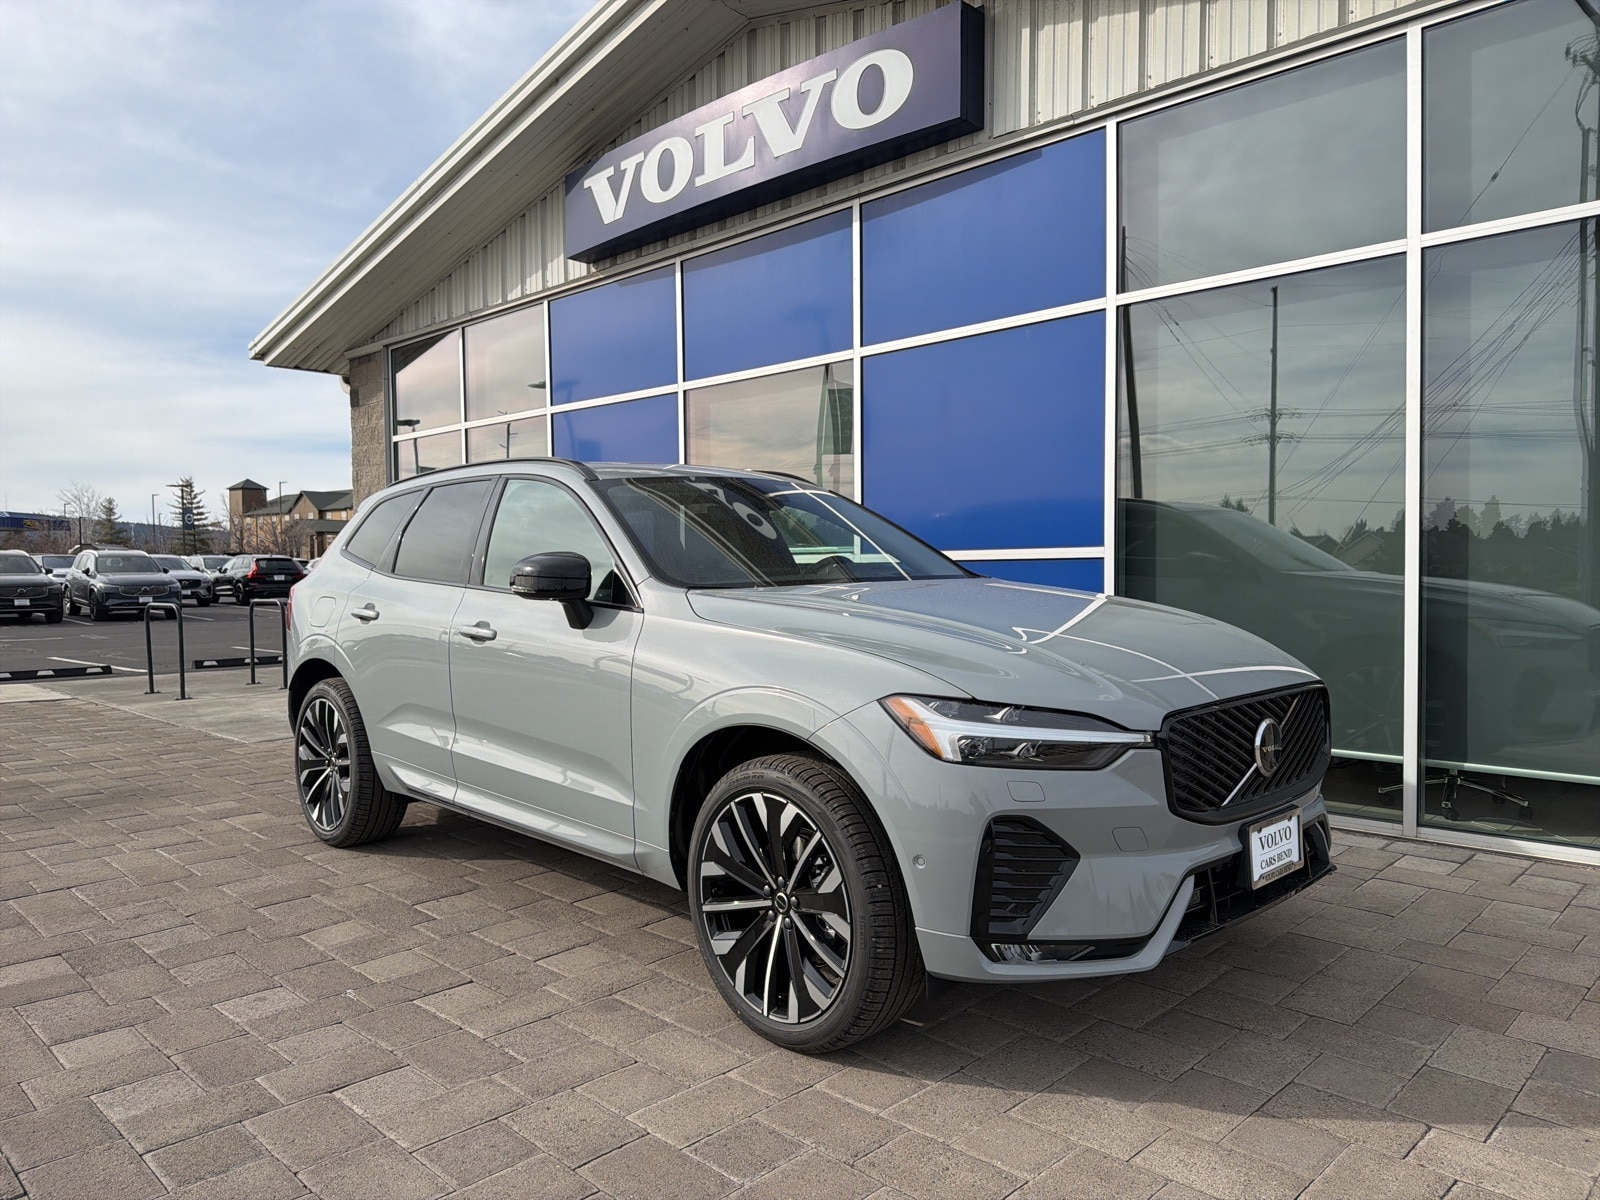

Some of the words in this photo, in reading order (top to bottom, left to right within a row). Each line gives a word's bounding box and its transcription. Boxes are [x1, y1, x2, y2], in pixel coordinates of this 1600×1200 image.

[583, 48, 914, 225] VOLVO
[1258, 825, 1292, 851] VOLVO
[1260, 853, 1277, 870] CARS
[1276, 848, 1293, 863] BEND
